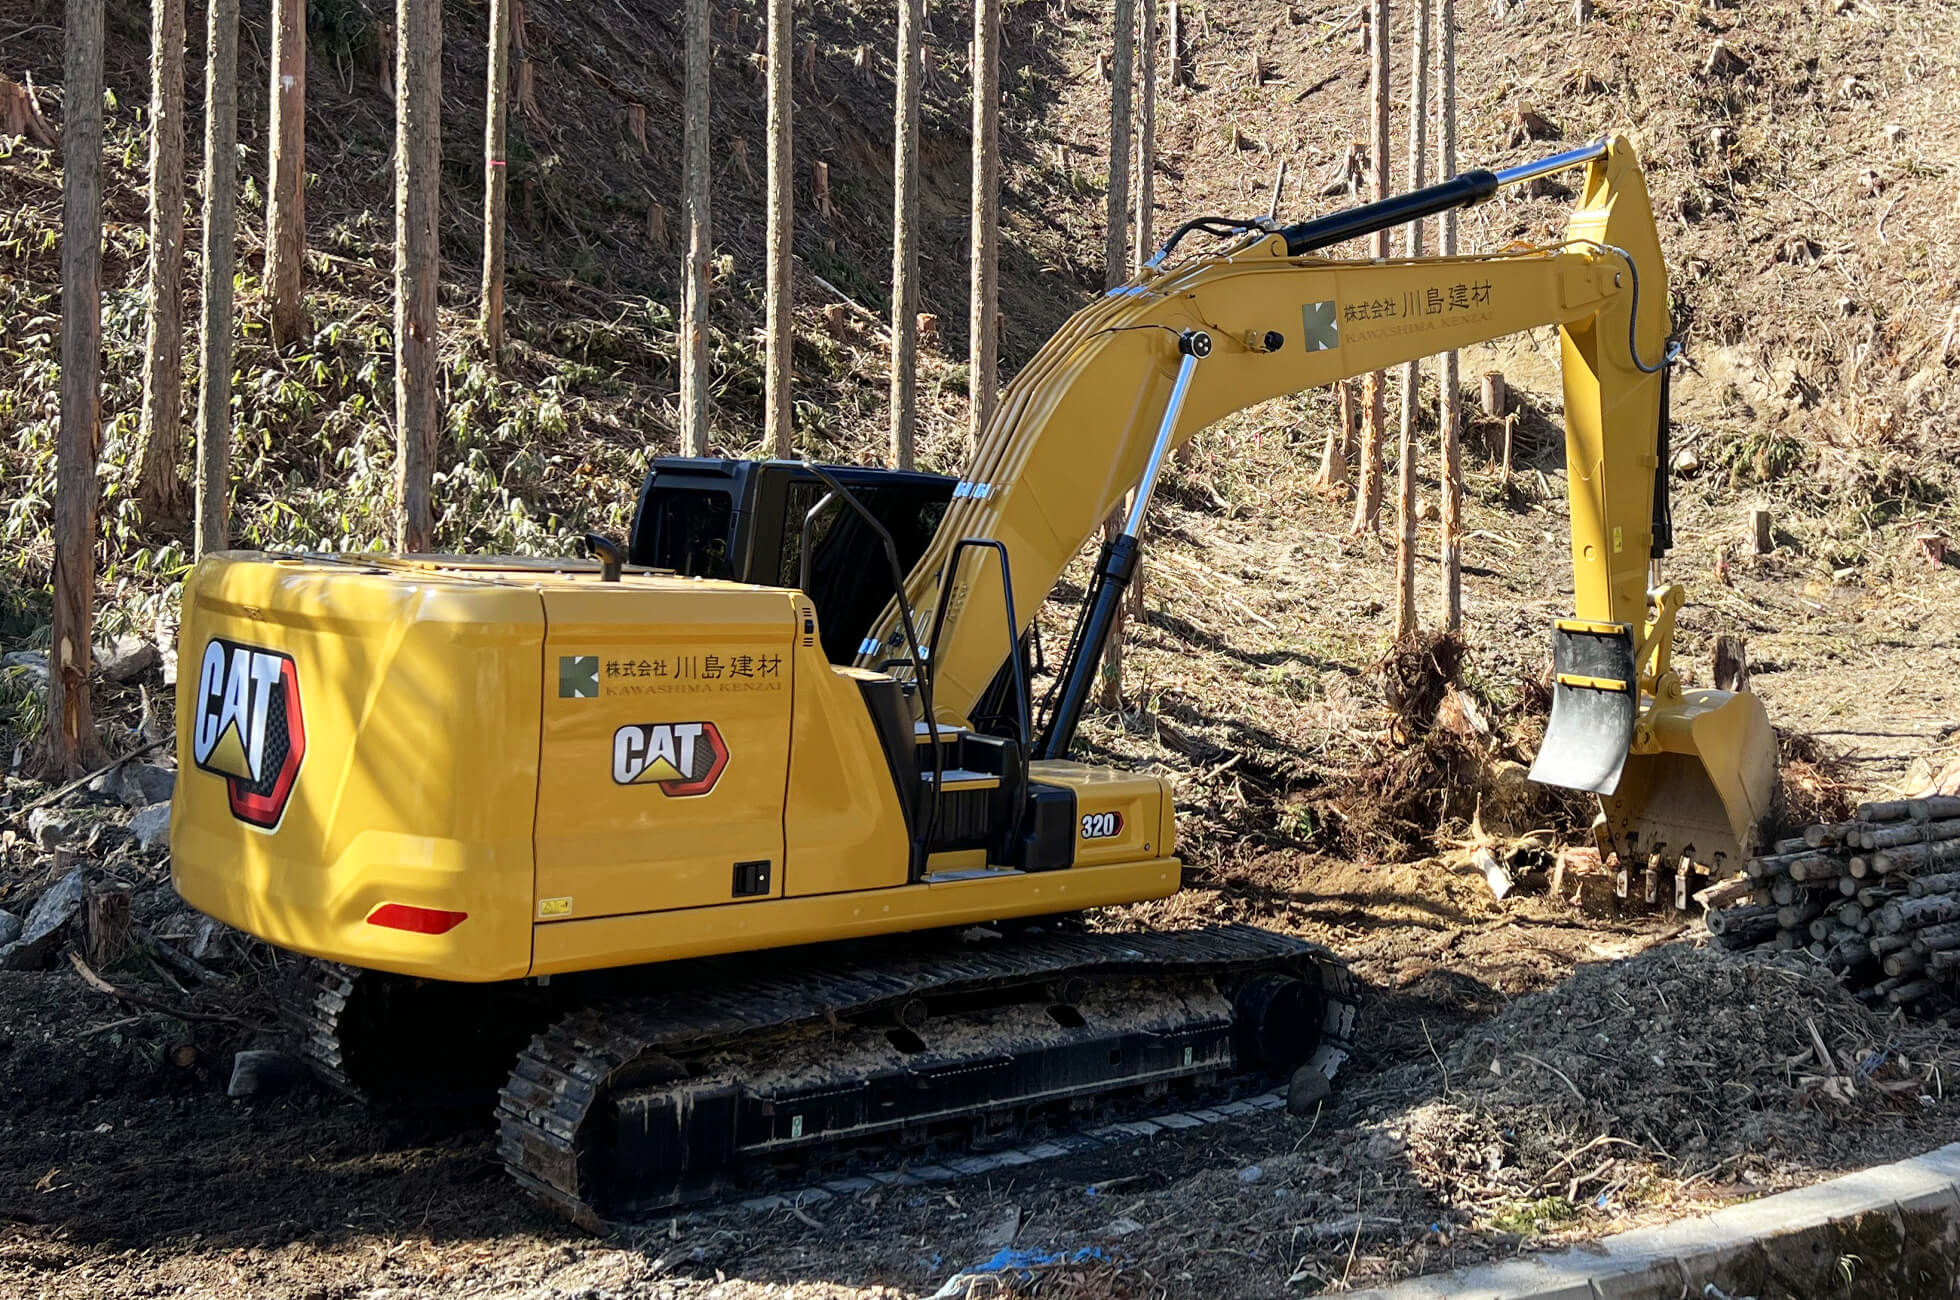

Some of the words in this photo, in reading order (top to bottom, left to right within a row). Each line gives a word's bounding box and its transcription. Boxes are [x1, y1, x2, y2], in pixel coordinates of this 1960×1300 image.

[1346, 321, 1435, 344] KAWASHIMA
[1441, 311, 1493, 329] KENZAI
[606, 684, 712, 697] KAWASHIMA
[720, 681, 782, 693] KENZAI
[195, 640, 282, 782] CAT
[612, 723, 702, 784] CAT
[1082, 813, 1114, 837] 320
